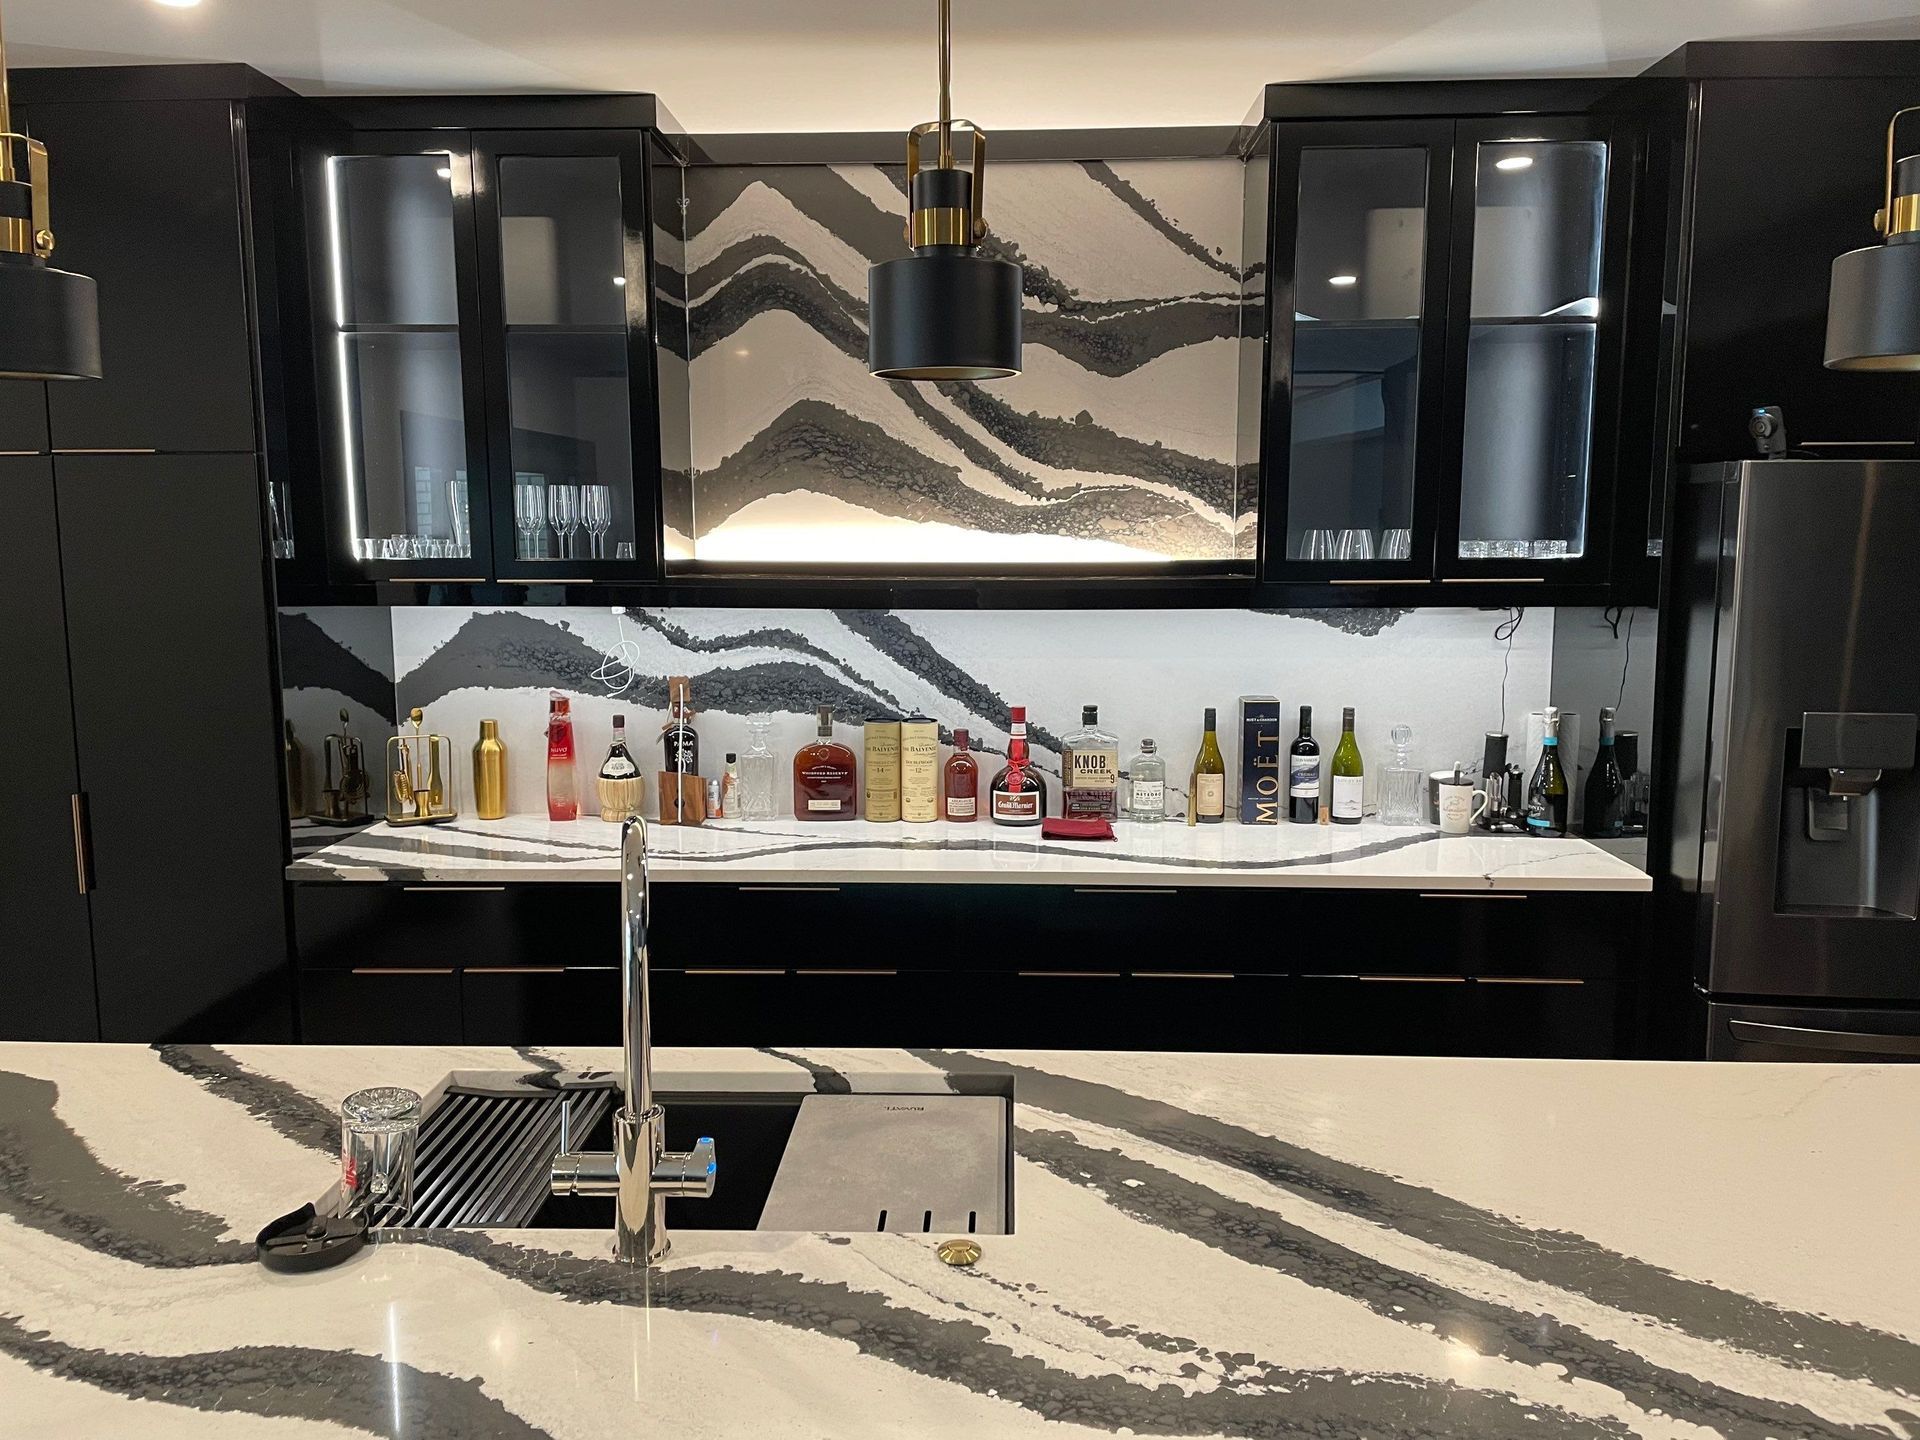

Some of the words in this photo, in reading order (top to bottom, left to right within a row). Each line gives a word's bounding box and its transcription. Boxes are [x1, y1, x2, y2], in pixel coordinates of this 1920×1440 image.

[1074, 755, 1106, 769] KNOB
[1110, 773, 1115, 784] 9
[1253, 730, 1278, 822] MOËT
